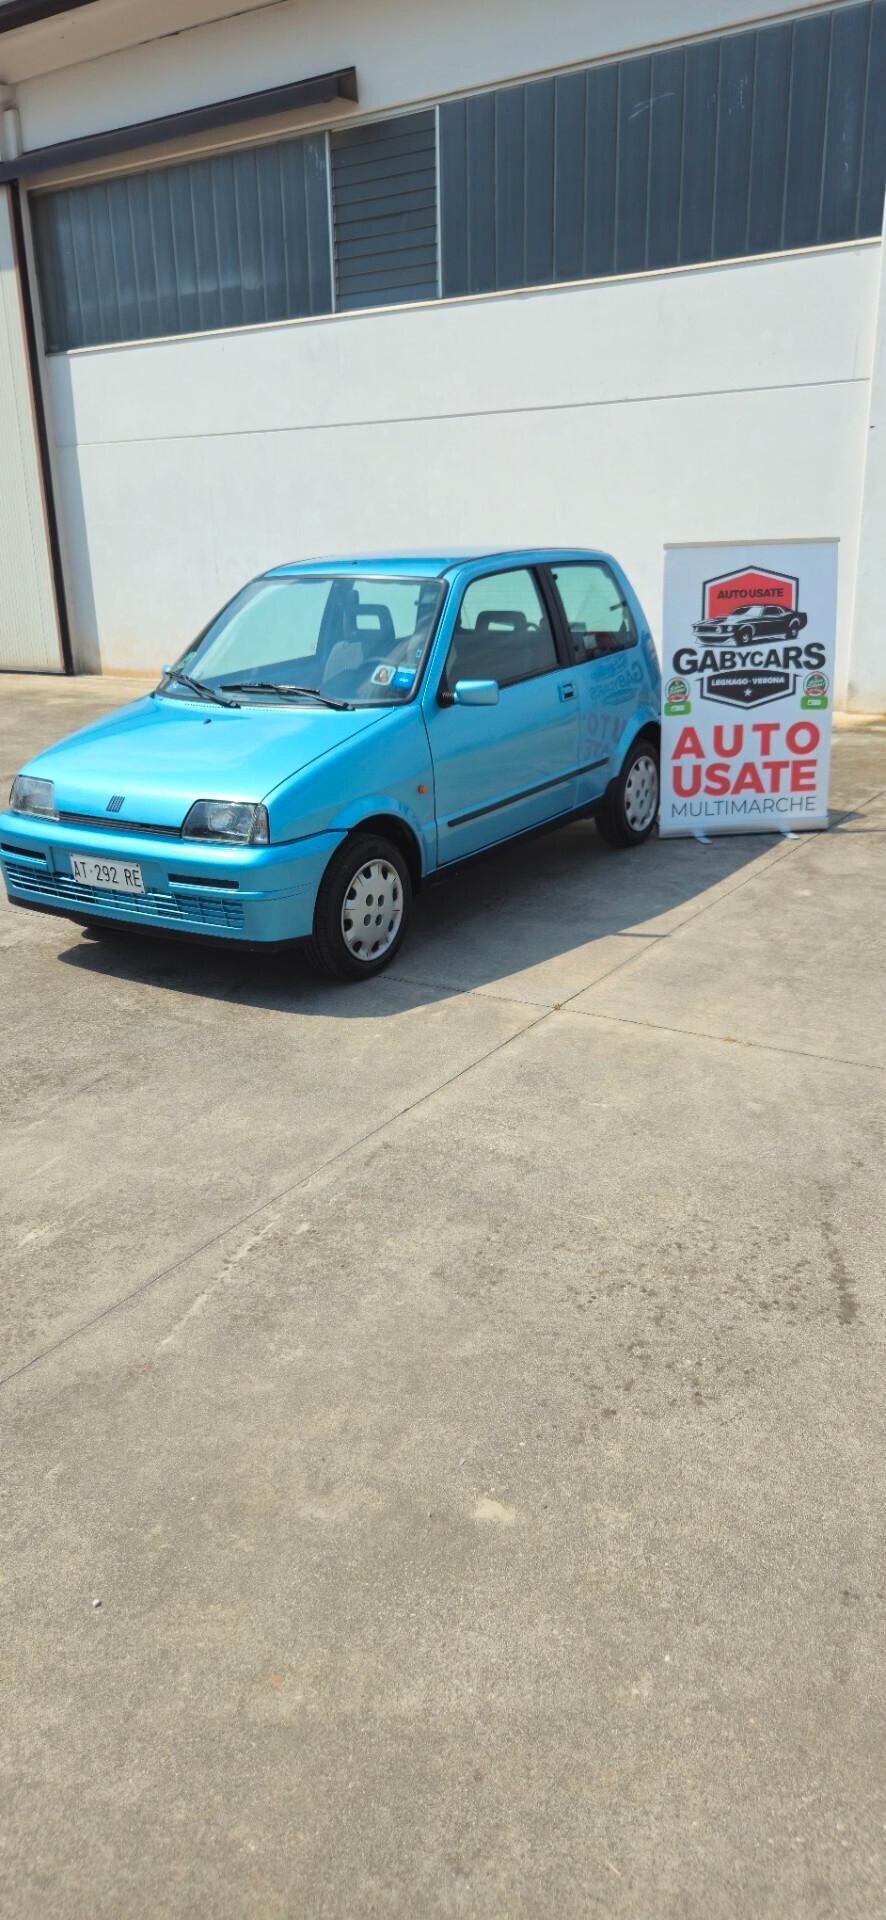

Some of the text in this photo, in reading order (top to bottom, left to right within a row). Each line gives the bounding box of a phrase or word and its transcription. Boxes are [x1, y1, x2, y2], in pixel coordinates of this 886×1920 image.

[717, 588, 785, 599] AUTO USATE
[672, 643, 826, 675] GABYCARS
[752, 677, 785, 685] VERONA
[671, 721, 820, 760] AUTO
[672, 759, 817, 798] USATE
[671, 797, 817, 817] MULTIMARCHE
[74, 861, 142, 887] AT 292 RE
